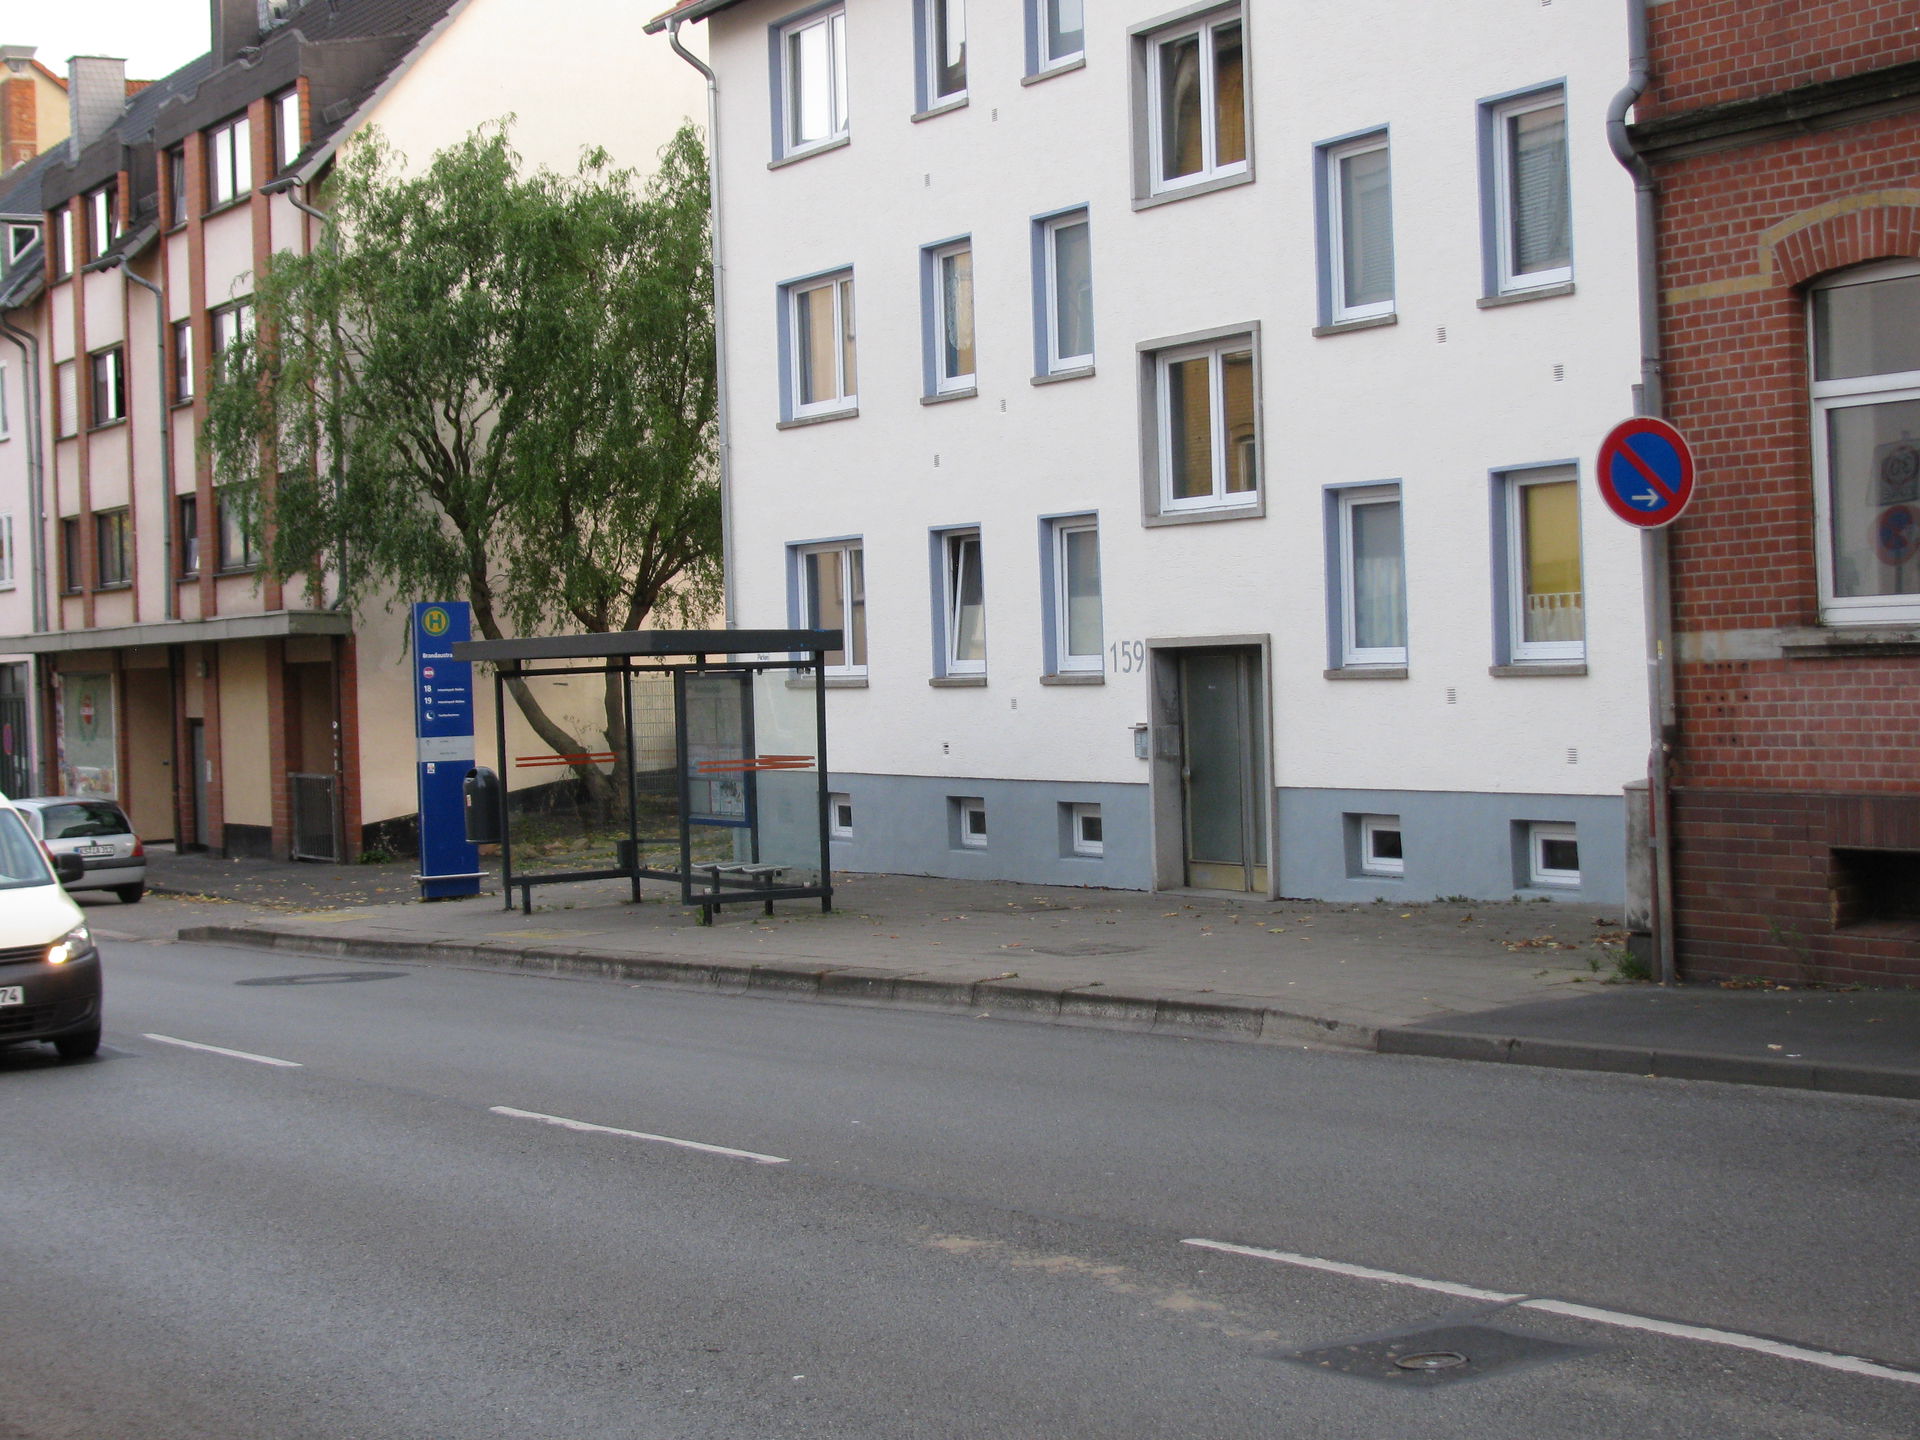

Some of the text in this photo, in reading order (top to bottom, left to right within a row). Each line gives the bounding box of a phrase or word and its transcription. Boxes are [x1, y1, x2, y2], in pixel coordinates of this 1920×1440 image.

[429, 613, 442, 629] H
[1110, 640, 1144, 673] 159
[423, 685, 432, 693] 18
[424, 697, 432, 705] 19
[0, 988, 17, 1002] 74
